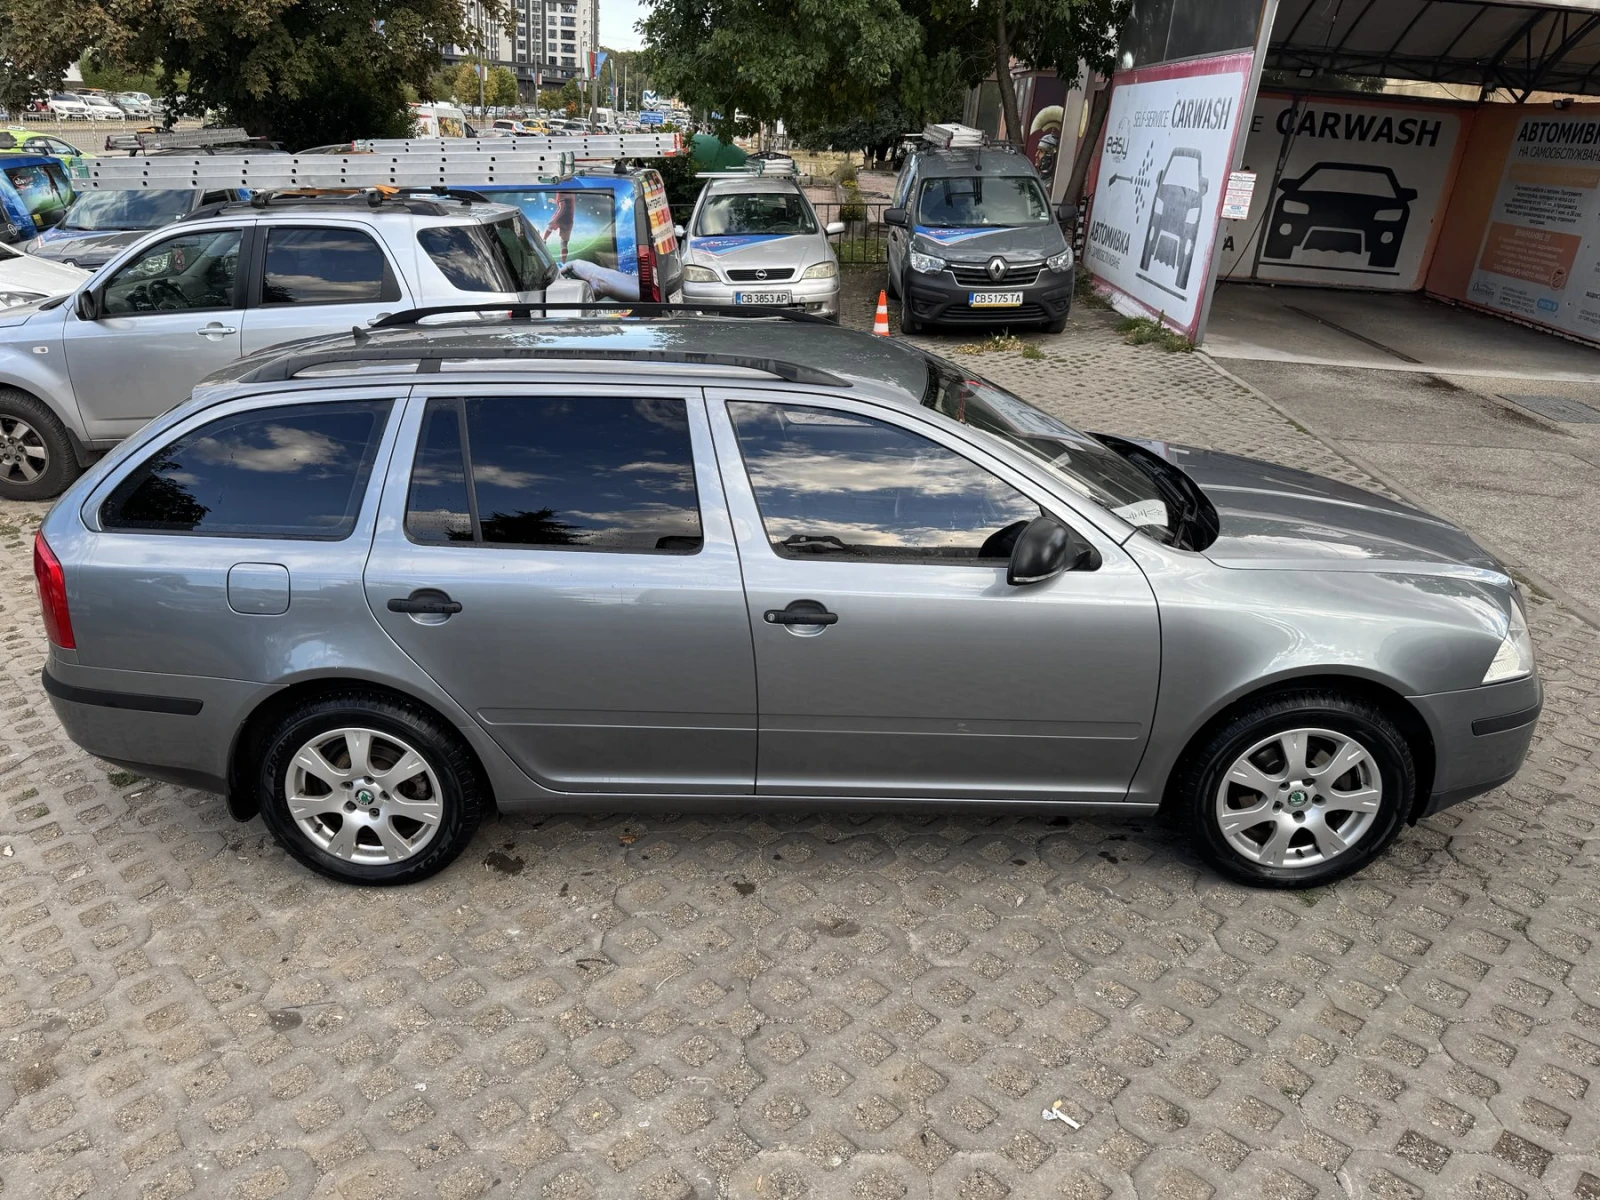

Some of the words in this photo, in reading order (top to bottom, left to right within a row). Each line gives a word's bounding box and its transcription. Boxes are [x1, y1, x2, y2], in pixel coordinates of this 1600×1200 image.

[1133, 110, 1170, 128] SELF-SERVICE
[1171, 97, 1233, 130] CARWASH
[1275, 107, 1442, 148] CARWASH
[1090, 220, 1131, 256] АВТОМИВКА
[741, 294, 753, 303] CB
[755, 294, 774, 303] 3853
[776, 294, 787, 303] AP
[974, 294, 986, 303] CB
[987, 294, 1009, 303] 5175
[1009, 294, 1021, 303] TA
